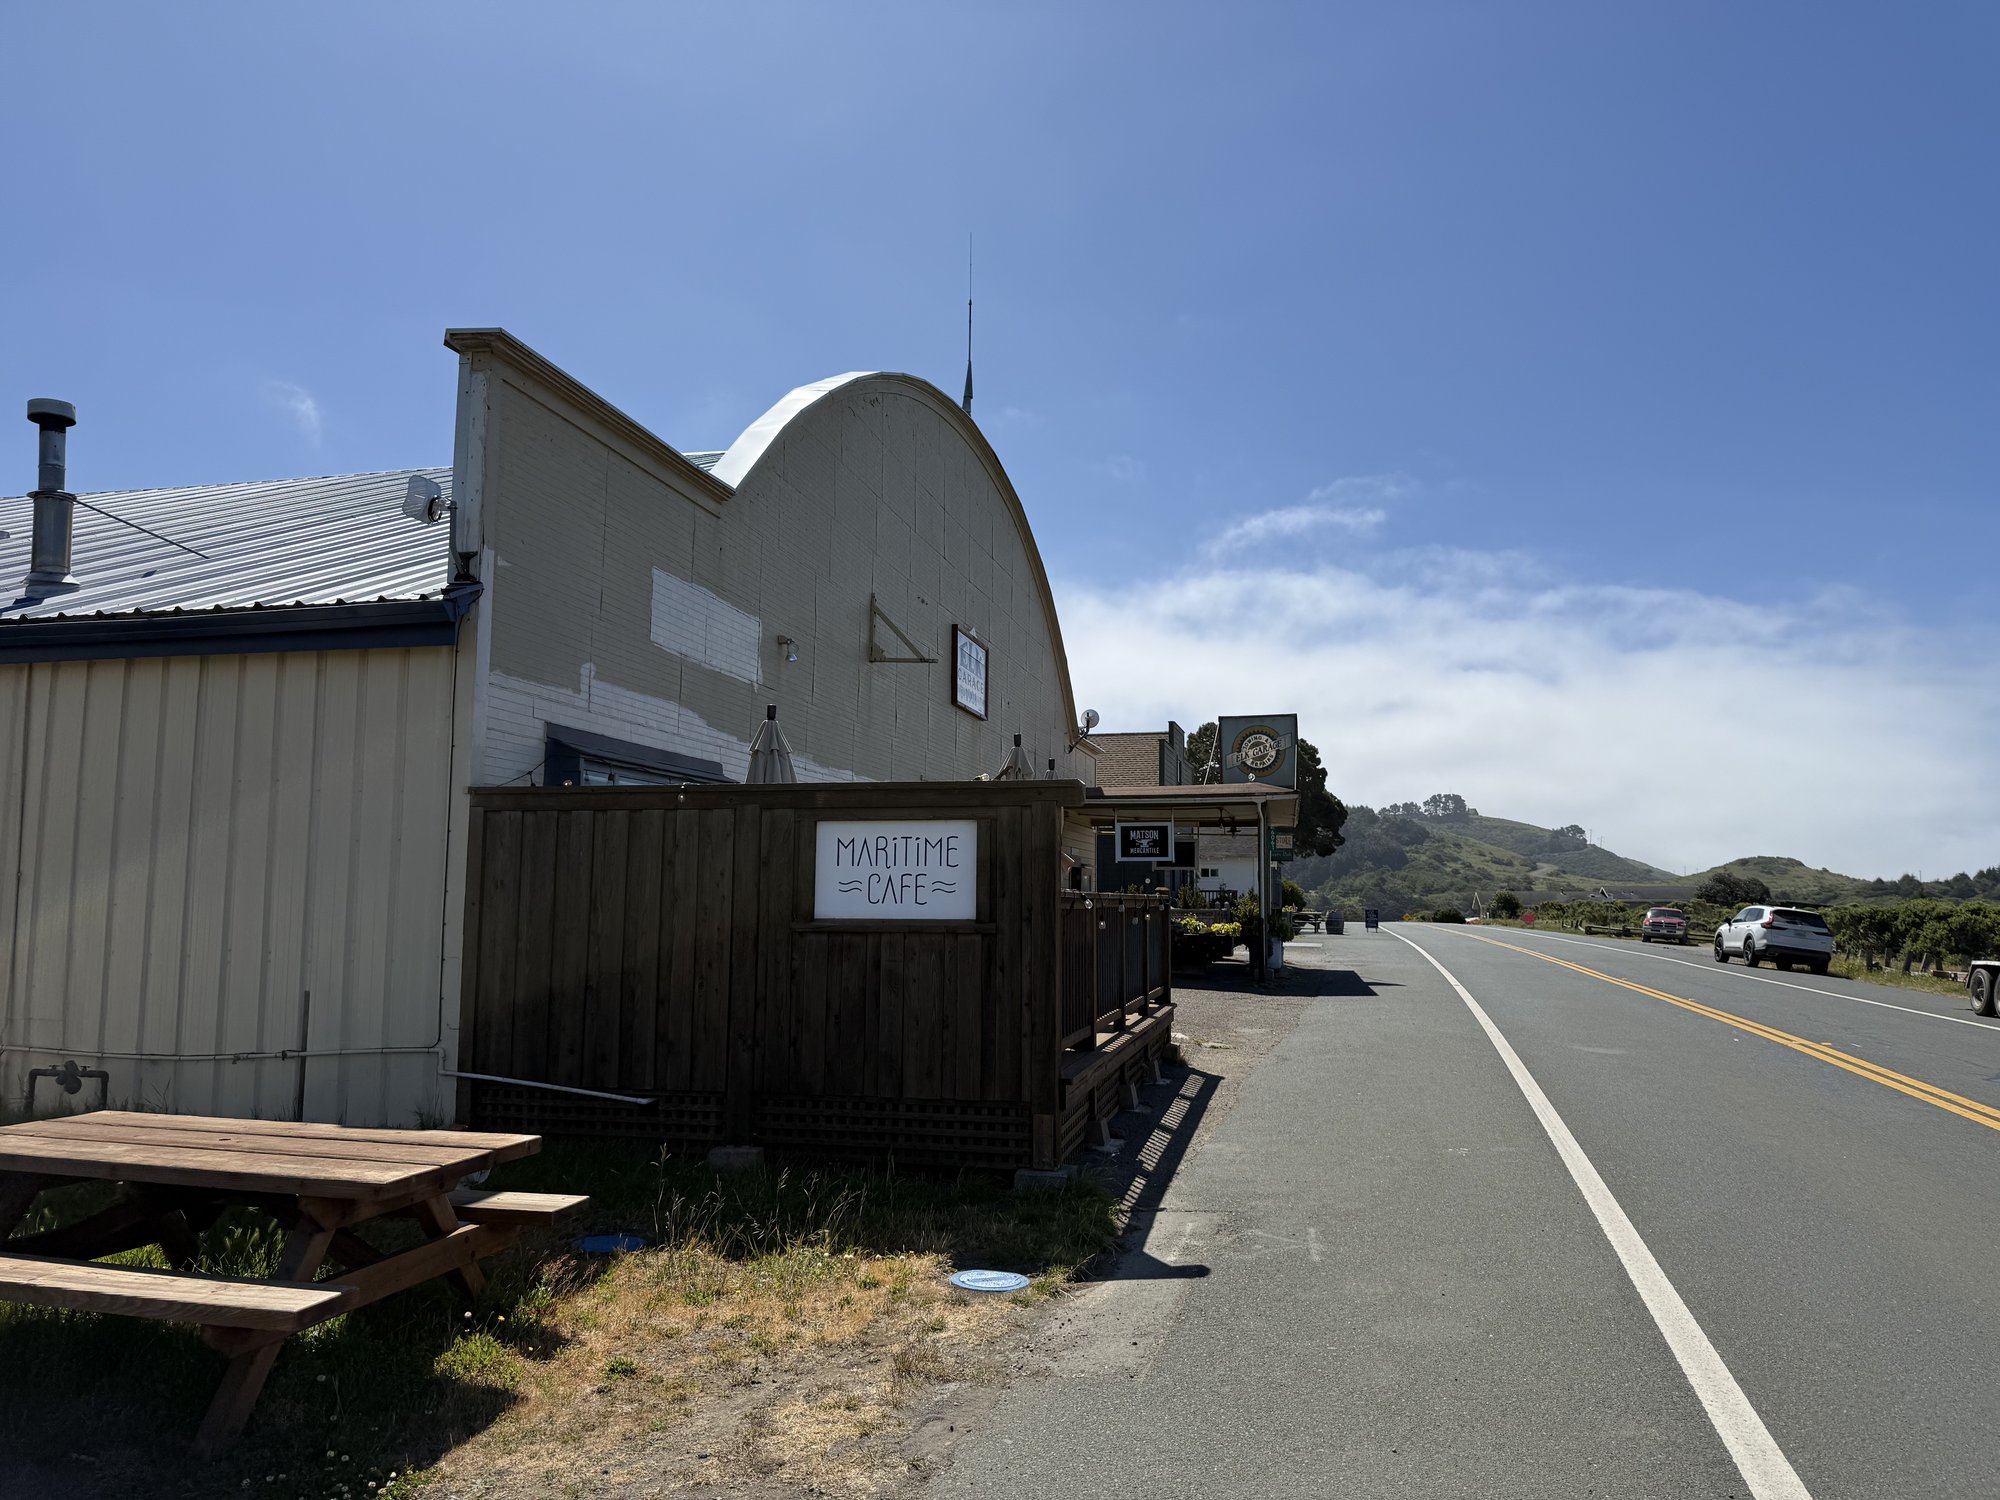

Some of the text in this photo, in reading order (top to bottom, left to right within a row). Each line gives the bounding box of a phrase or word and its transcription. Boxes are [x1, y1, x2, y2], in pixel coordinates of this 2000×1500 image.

[1236, 740, 1282, 762] ELK GARAGE
[1243, 735, 1263, 750] TOWING
[1130, 830, 1159, 840] MATSON
[868, 873, 927, 905] CAFE
